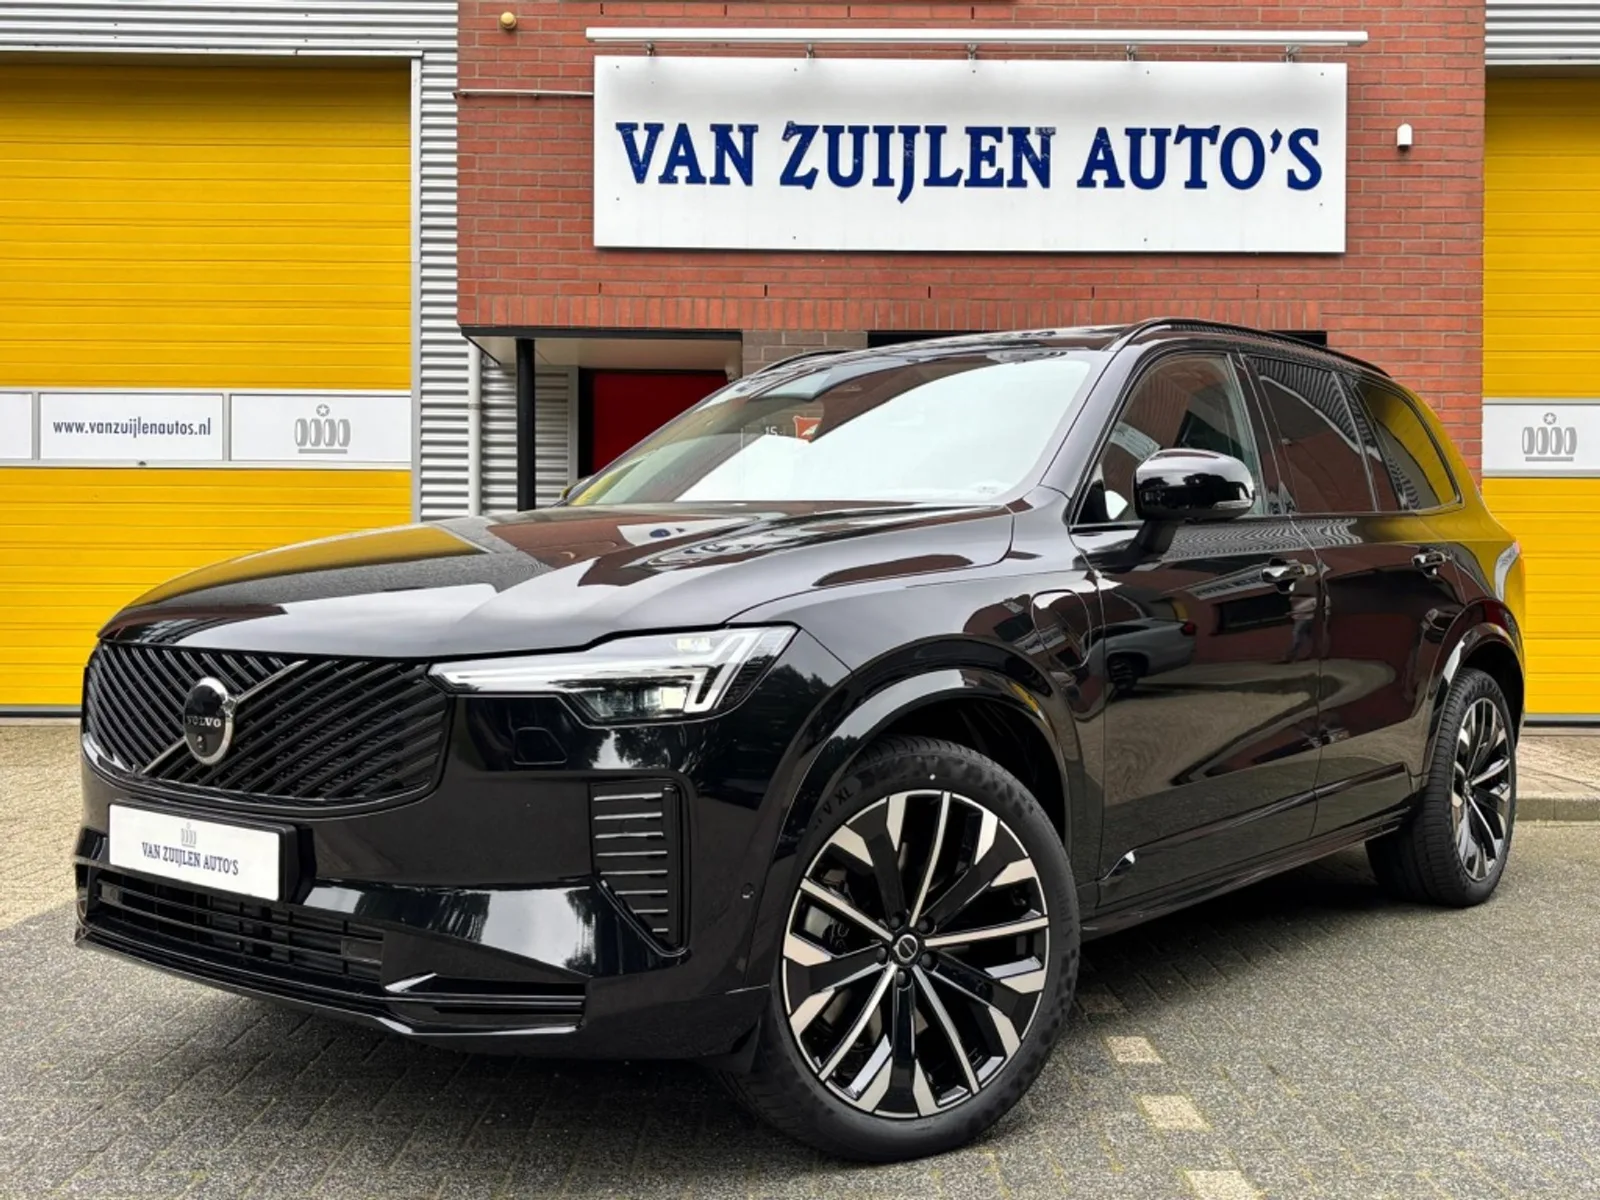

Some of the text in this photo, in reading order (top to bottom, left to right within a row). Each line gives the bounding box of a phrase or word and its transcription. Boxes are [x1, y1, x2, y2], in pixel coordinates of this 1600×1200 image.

[615, 120, 1323, 204] VAN ZUIJLEN AUTO'S
[53, 416, 211, 438] www.vanzuijlenautos.nl
[186, 715, 222, 728] VOLVO
[141, 841, 239, 876] VAN ZUIJLEN AUTO'S
